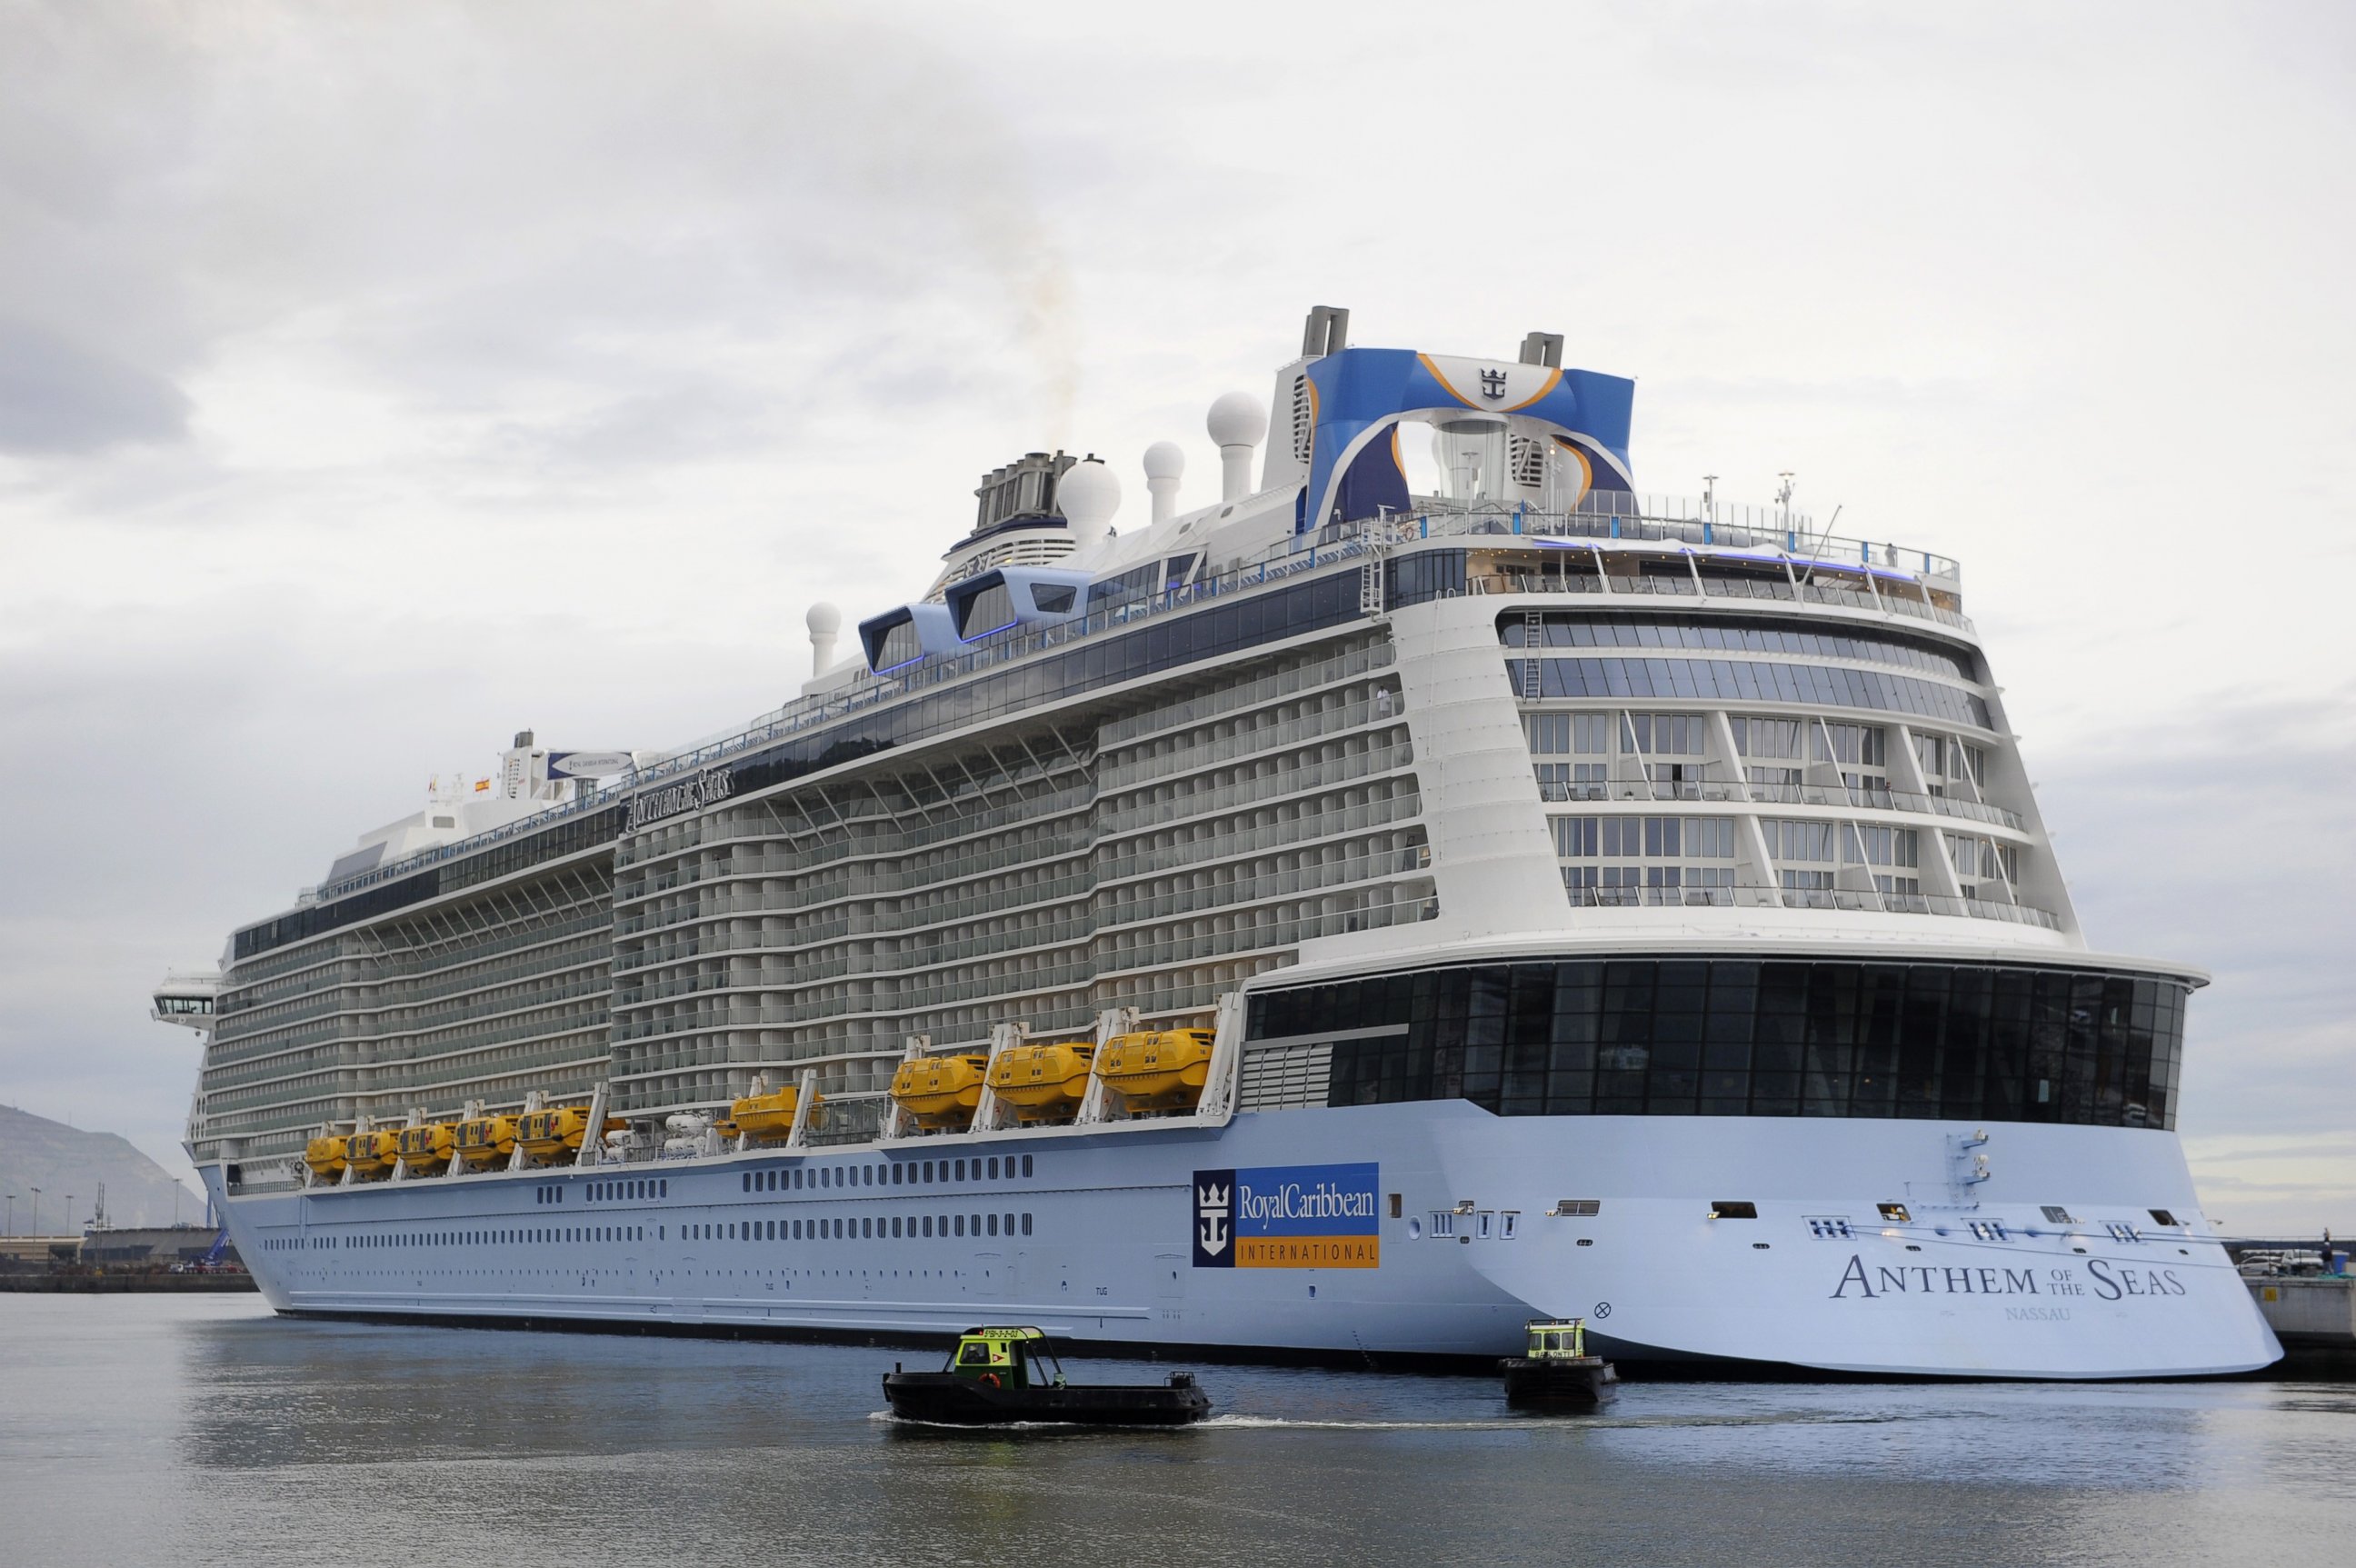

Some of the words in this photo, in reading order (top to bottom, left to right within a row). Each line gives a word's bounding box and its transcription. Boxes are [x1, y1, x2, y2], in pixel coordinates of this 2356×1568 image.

[1241, 1243, 1374, 1260] INTERNATIONAL
[1828, 1253, 2041, 1299] ANTHEM
[2051, 1268, 2072, 1282] OF
[2087, 1259, 2186, 1301] SEAS
[1095, 1286, 1108, 1295] TUG
[2047, 1283, 2085, 1295] THE
[2004, 1307, 2071, 1321] NASSAU
